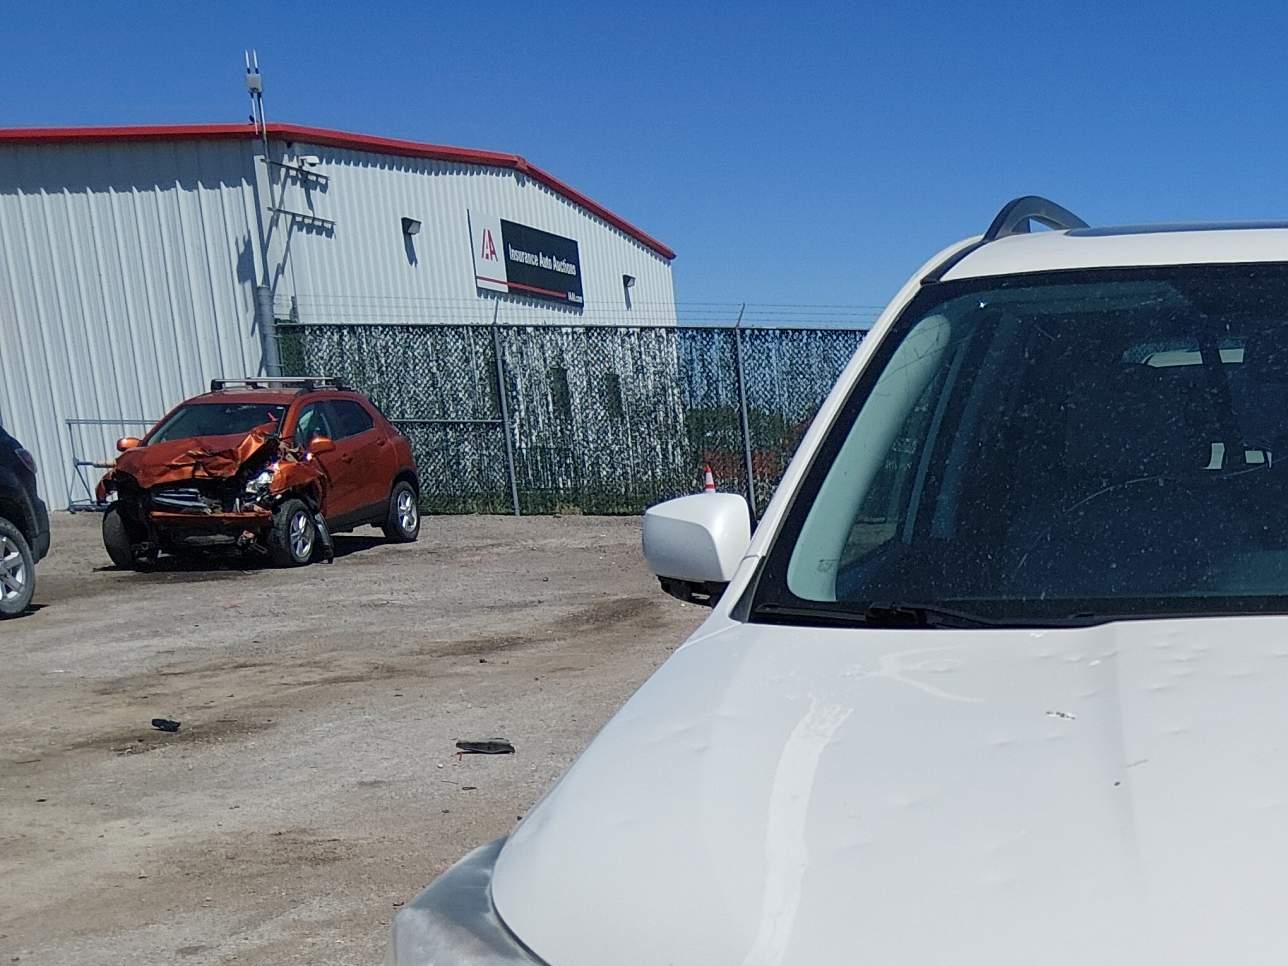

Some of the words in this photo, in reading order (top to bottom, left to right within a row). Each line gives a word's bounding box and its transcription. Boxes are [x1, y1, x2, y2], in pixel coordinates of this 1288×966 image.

[508, 242, 539, 267] Insurance
[539, 251, 553, 270] Auto
[553, 255, 577, 277] Auctions
